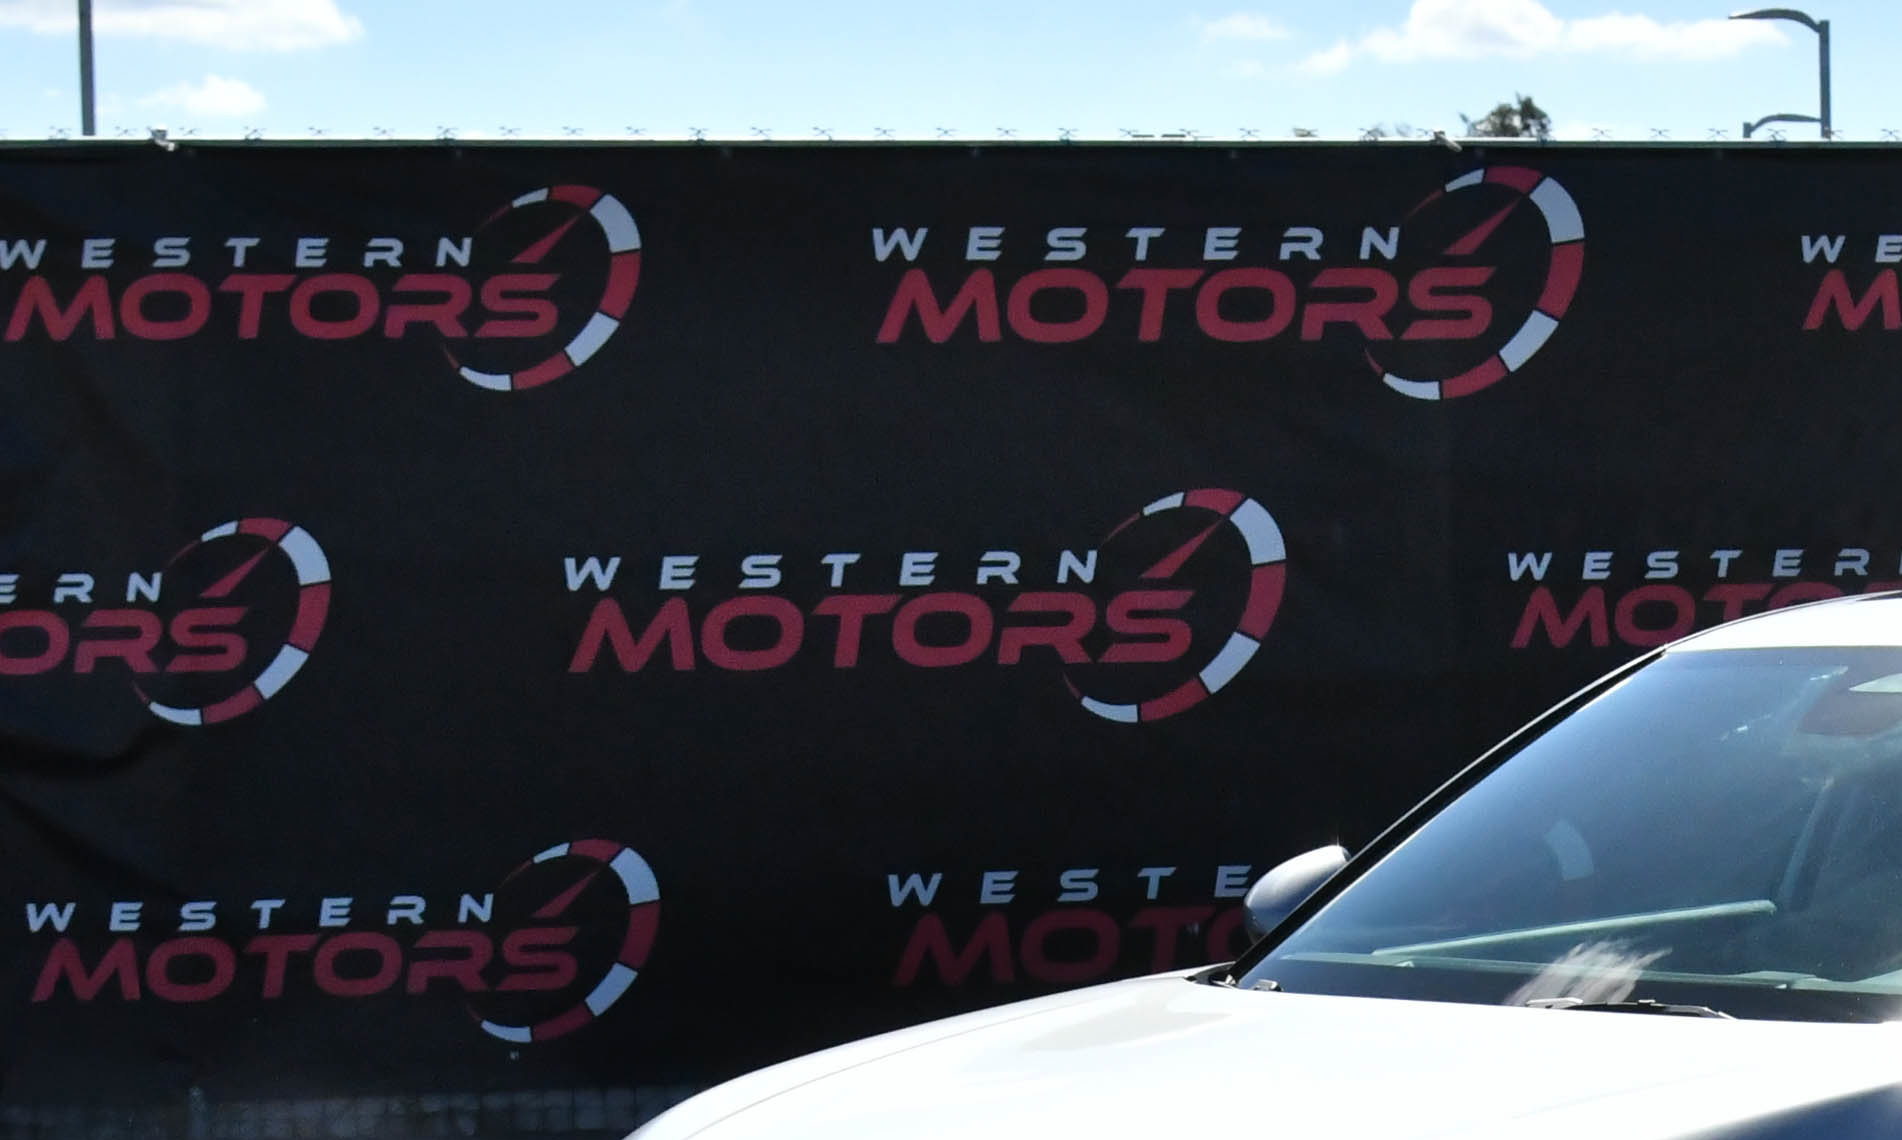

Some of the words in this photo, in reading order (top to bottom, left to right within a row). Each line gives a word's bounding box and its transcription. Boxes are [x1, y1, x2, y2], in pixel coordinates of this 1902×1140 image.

[0, 237, 472, 270] WESTERN
[872, 226, 1400, 262] WESTERN
[4, 271, 560, 341] MOTORS
[877, 266, 1495, 342] MOTORS
[564, 549, 1098, 592] WESTERN
[570, 589, 1194, 673] MOTORS
[26, 893, 494, 933] WESTERN
[32, 928, 578, 1001] MOTORS
